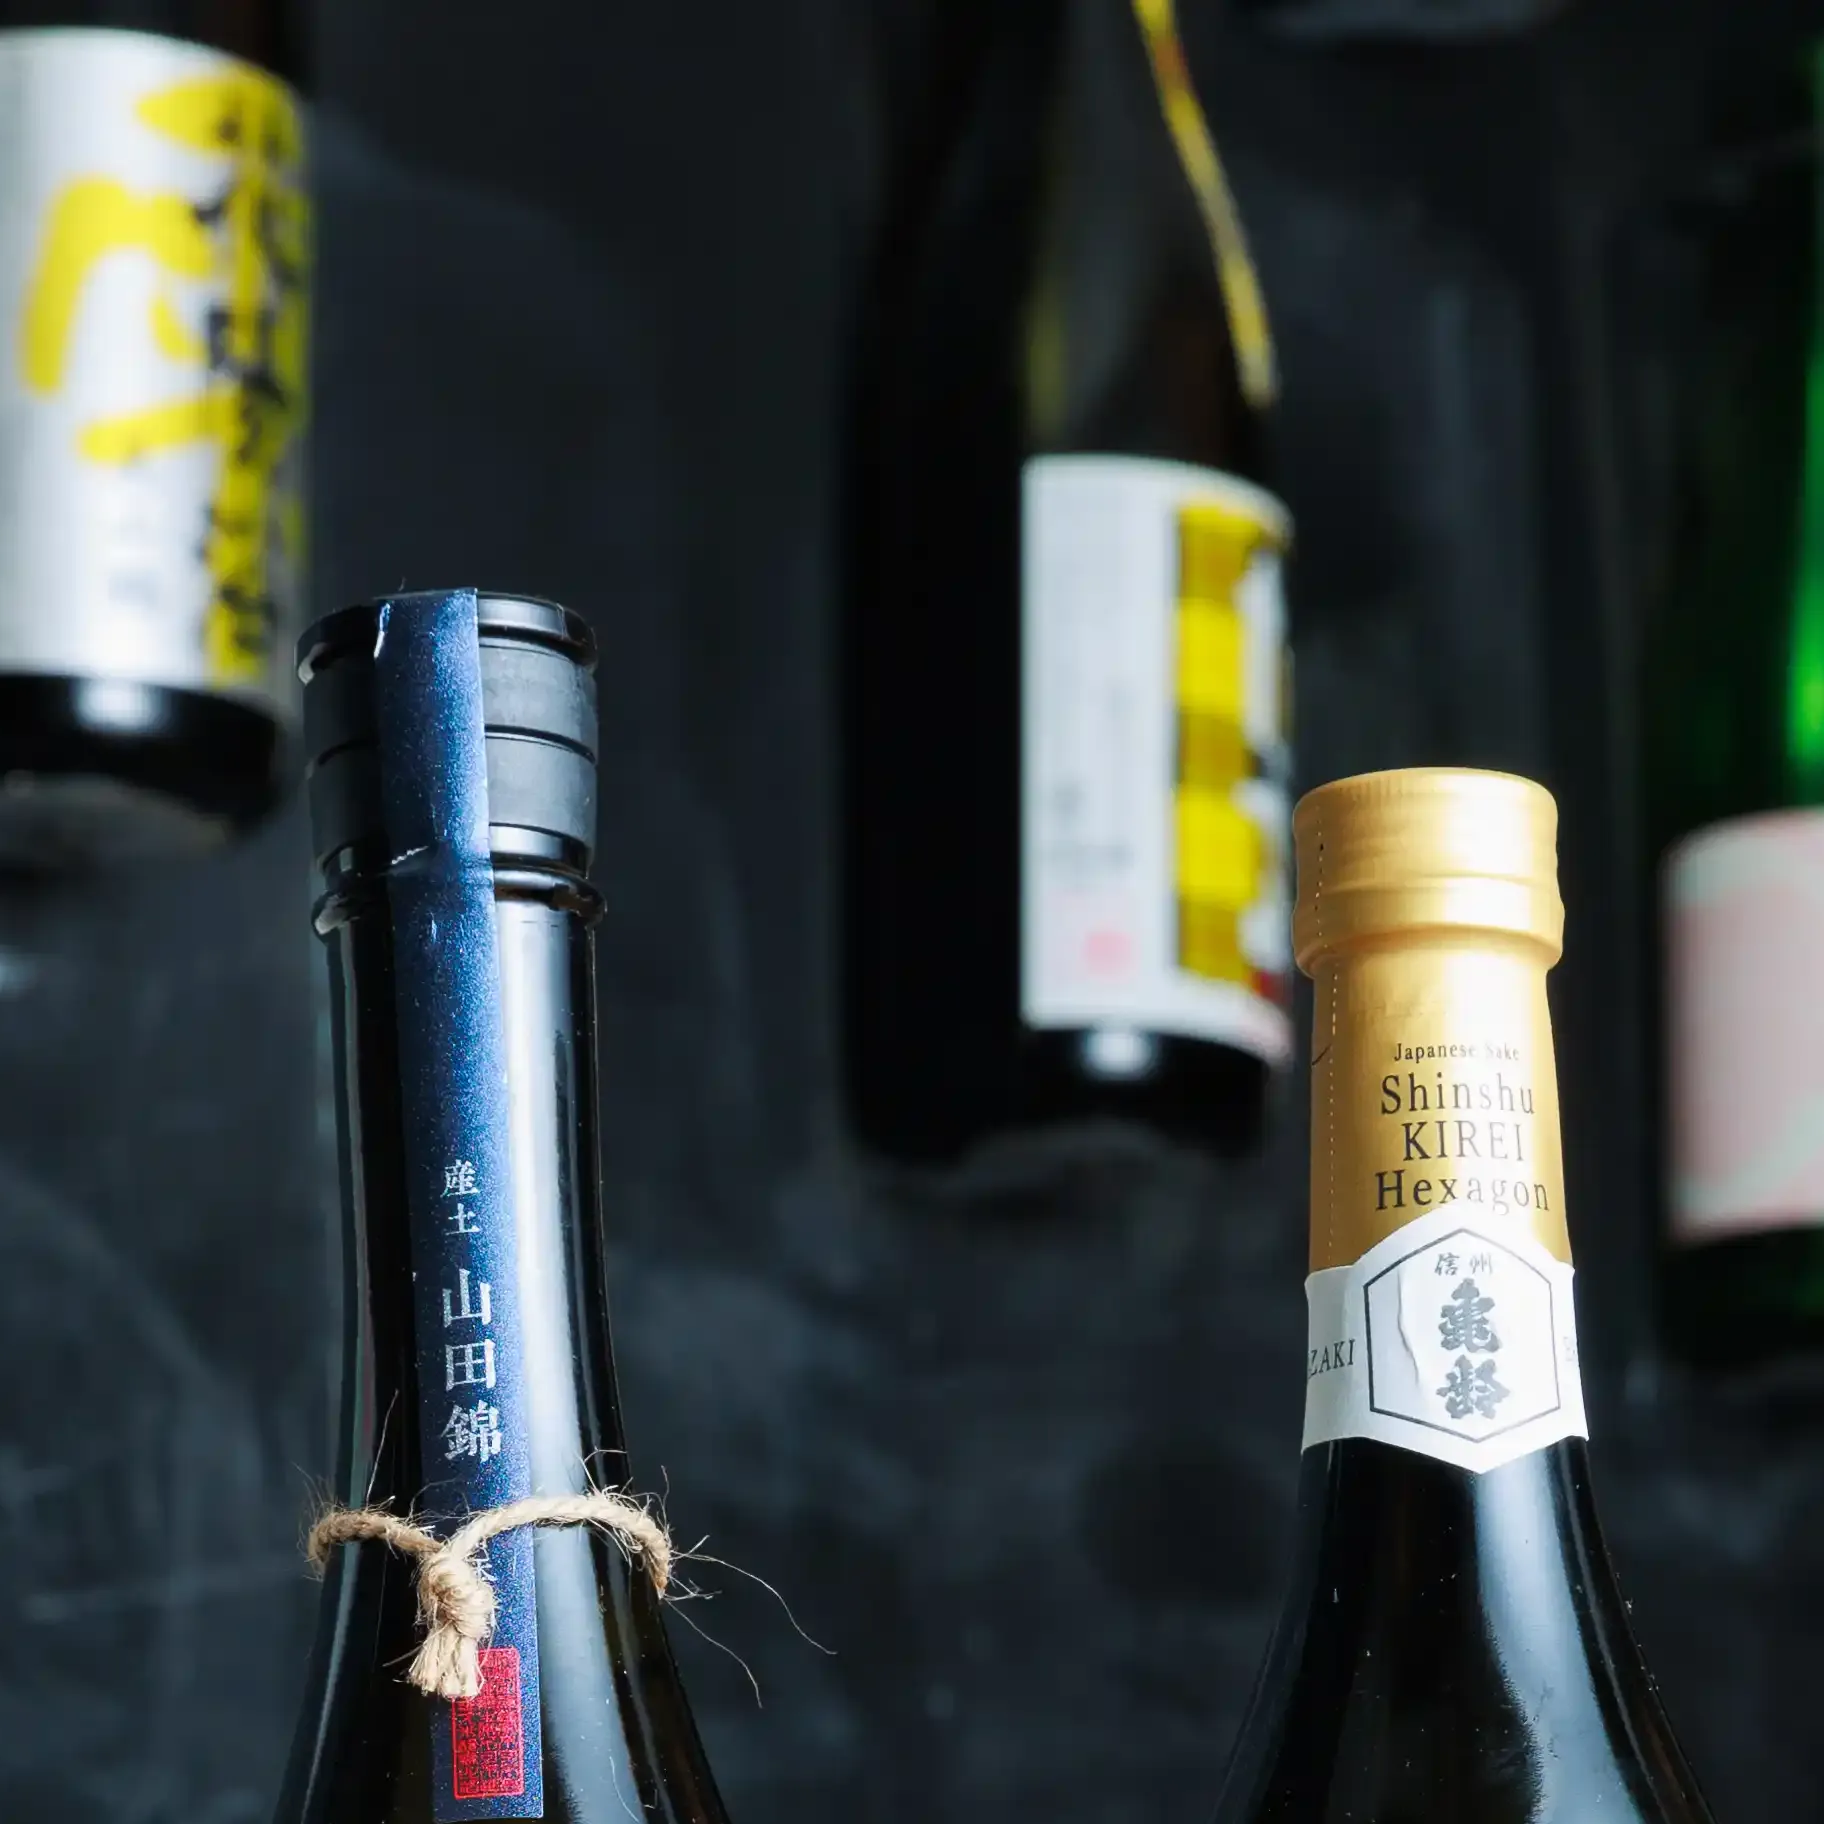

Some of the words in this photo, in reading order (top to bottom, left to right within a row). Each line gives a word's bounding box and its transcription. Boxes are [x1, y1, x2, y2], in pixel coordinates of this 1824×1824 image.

[1393, 1042, 1477, 1065] Japanese
[1484, 1042, 1520, 1061] Sake
[1380, 1071, 1536, 1117] Shinshu
[1402, 1120, 1525, 1162] KIREI
[440, 1158, 482, 1238] 産土
[1374, 1168, 1551, 1216] Hexagon
[1434, 1251, 1495, 1277] 信州
[441, 1266, 503, 1464] 山田錦
